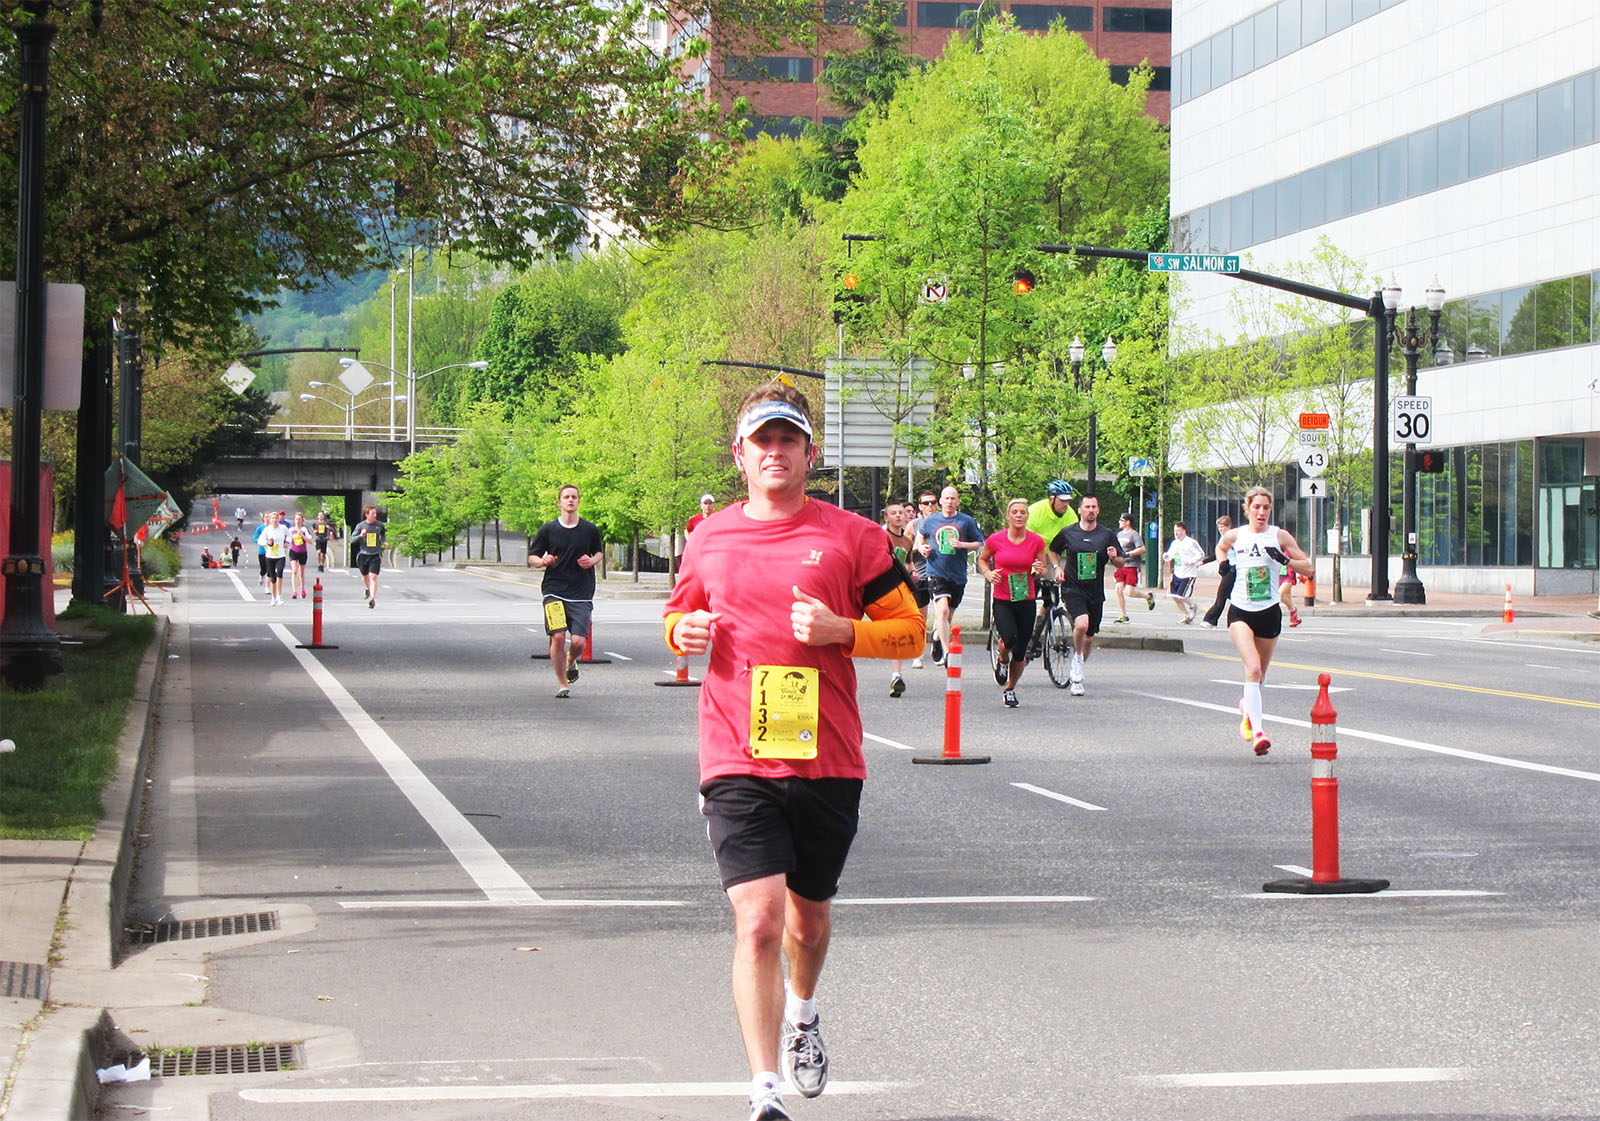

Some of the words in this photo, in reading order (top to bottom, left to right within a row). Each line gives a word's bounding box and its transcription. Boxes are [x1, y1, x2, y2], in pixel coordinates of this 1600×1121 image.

[1168, 258, 1180, 270] SW
[1183, 256, 1225, 271] SALMON
[1227, 259, 1236, 271] ST
[1397, 400, 1429, 410] SPEED
[1302, 415, 1328, 426] DETOUR
[1396, 412, 1430, 439] 30
[1301, 433, 1327, 443] SOUTH
[1305, 453, 1324, 467] 43
